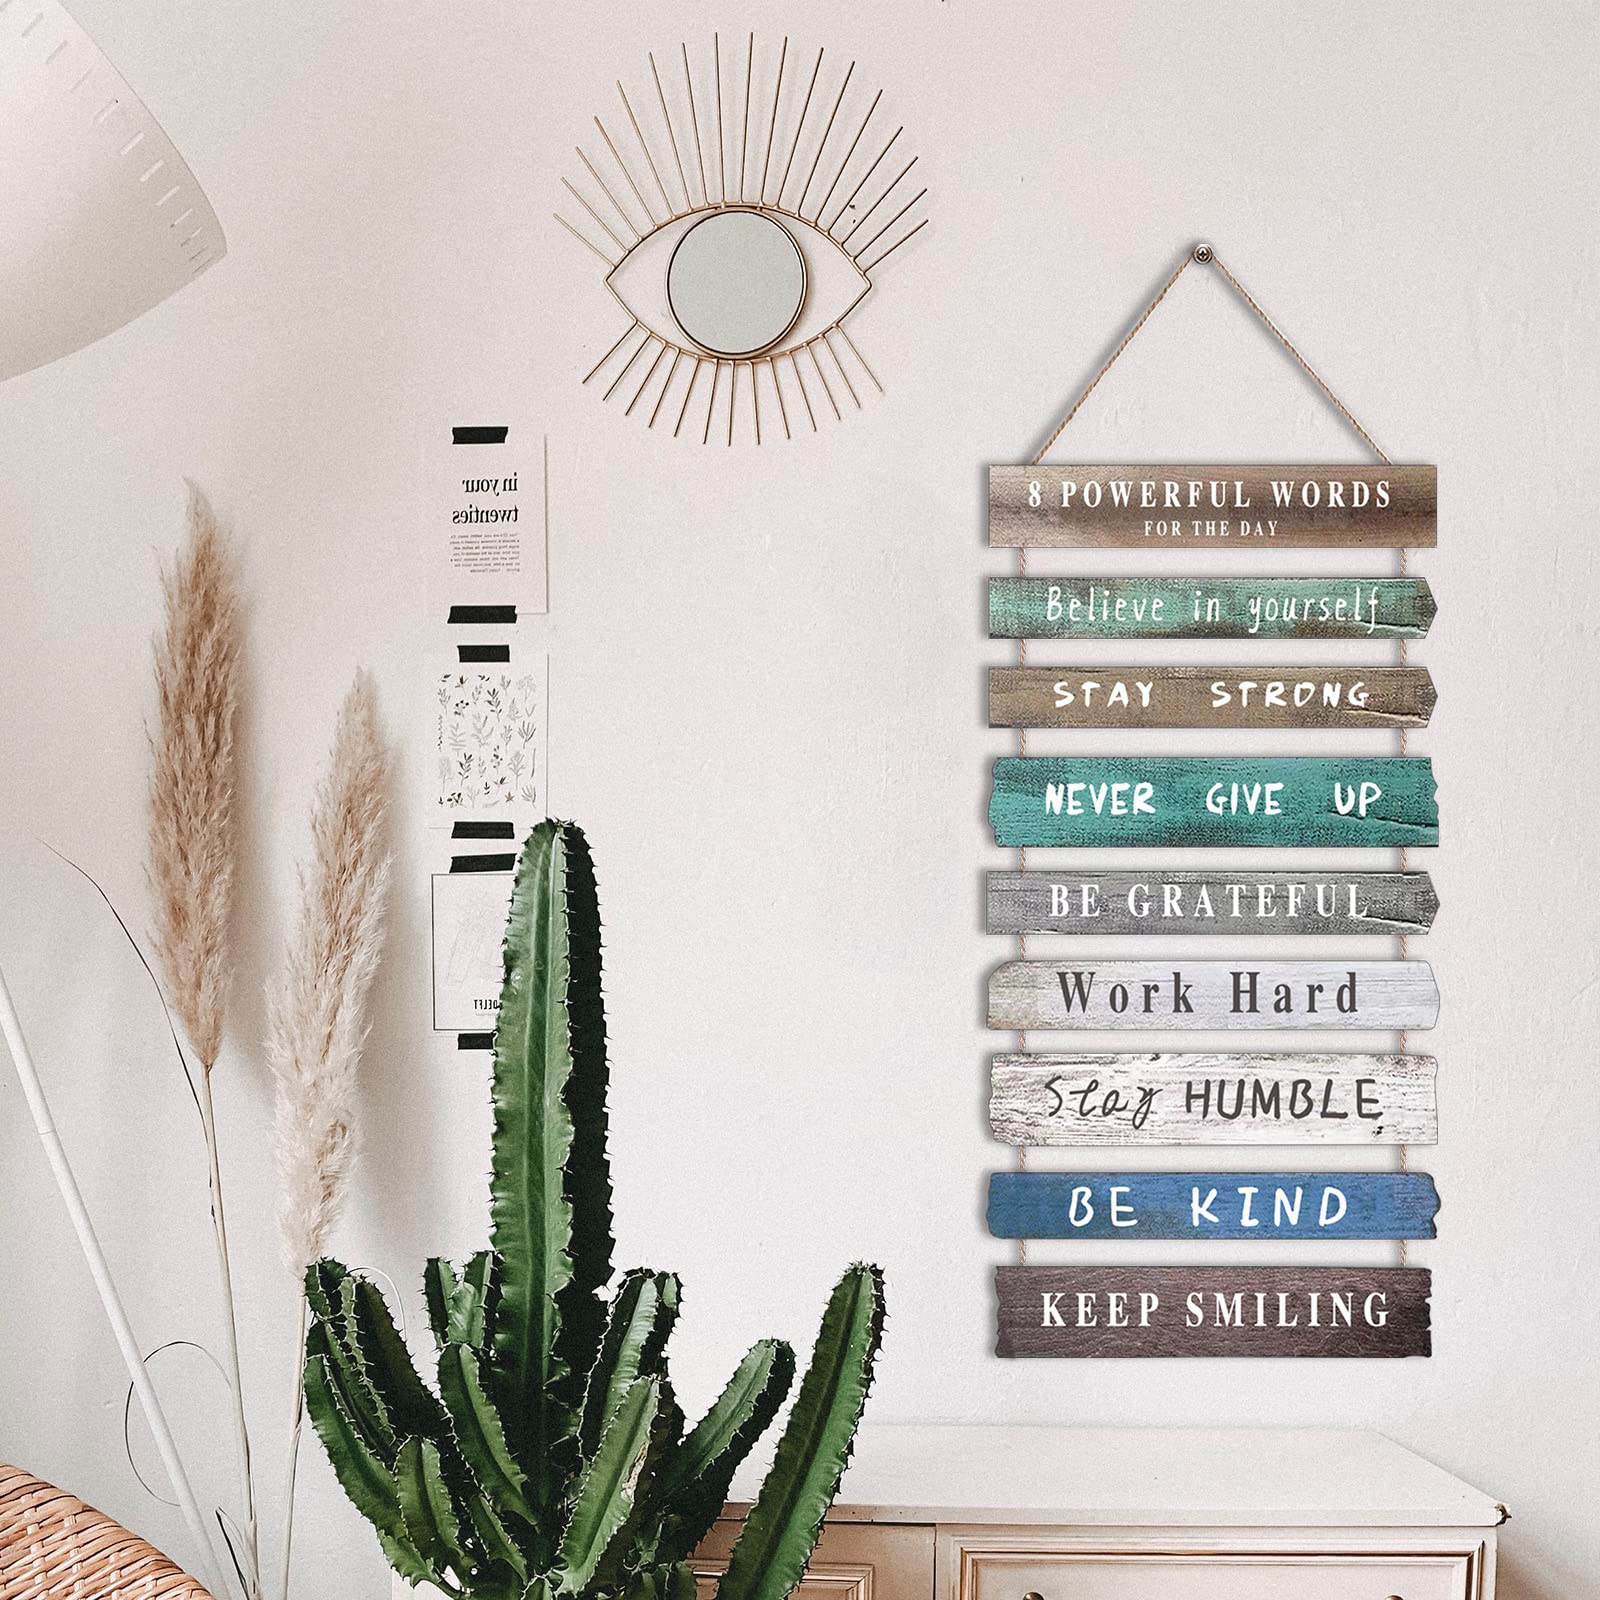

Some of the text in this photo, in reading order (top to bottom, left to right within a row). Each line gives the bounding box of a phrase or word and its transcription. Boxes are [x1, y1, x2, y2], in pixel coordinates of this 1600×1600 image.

[1028, 480, 1392, 508] 8 POWERFUL WORDS
[1144, 520, 1279, 537] FOR THE DAY
[1046, 585, 1380, 634] Believe in yourself
[1053, 681, 1370, 708] STAY STRONG
[1045, 782, 1382, 815] NEVER GIVE UP
[1049, 883, 1369, 918] BE GRATEFUL
[1056, 971, 1359, 1014] Work Hard
[1044, 1075, 1384, 1129] Stay HUMBLE
[1068, 1186, 1348, 1228] BE KIND
[1040, 1292, 1390, 1327] KEEP SMILING
